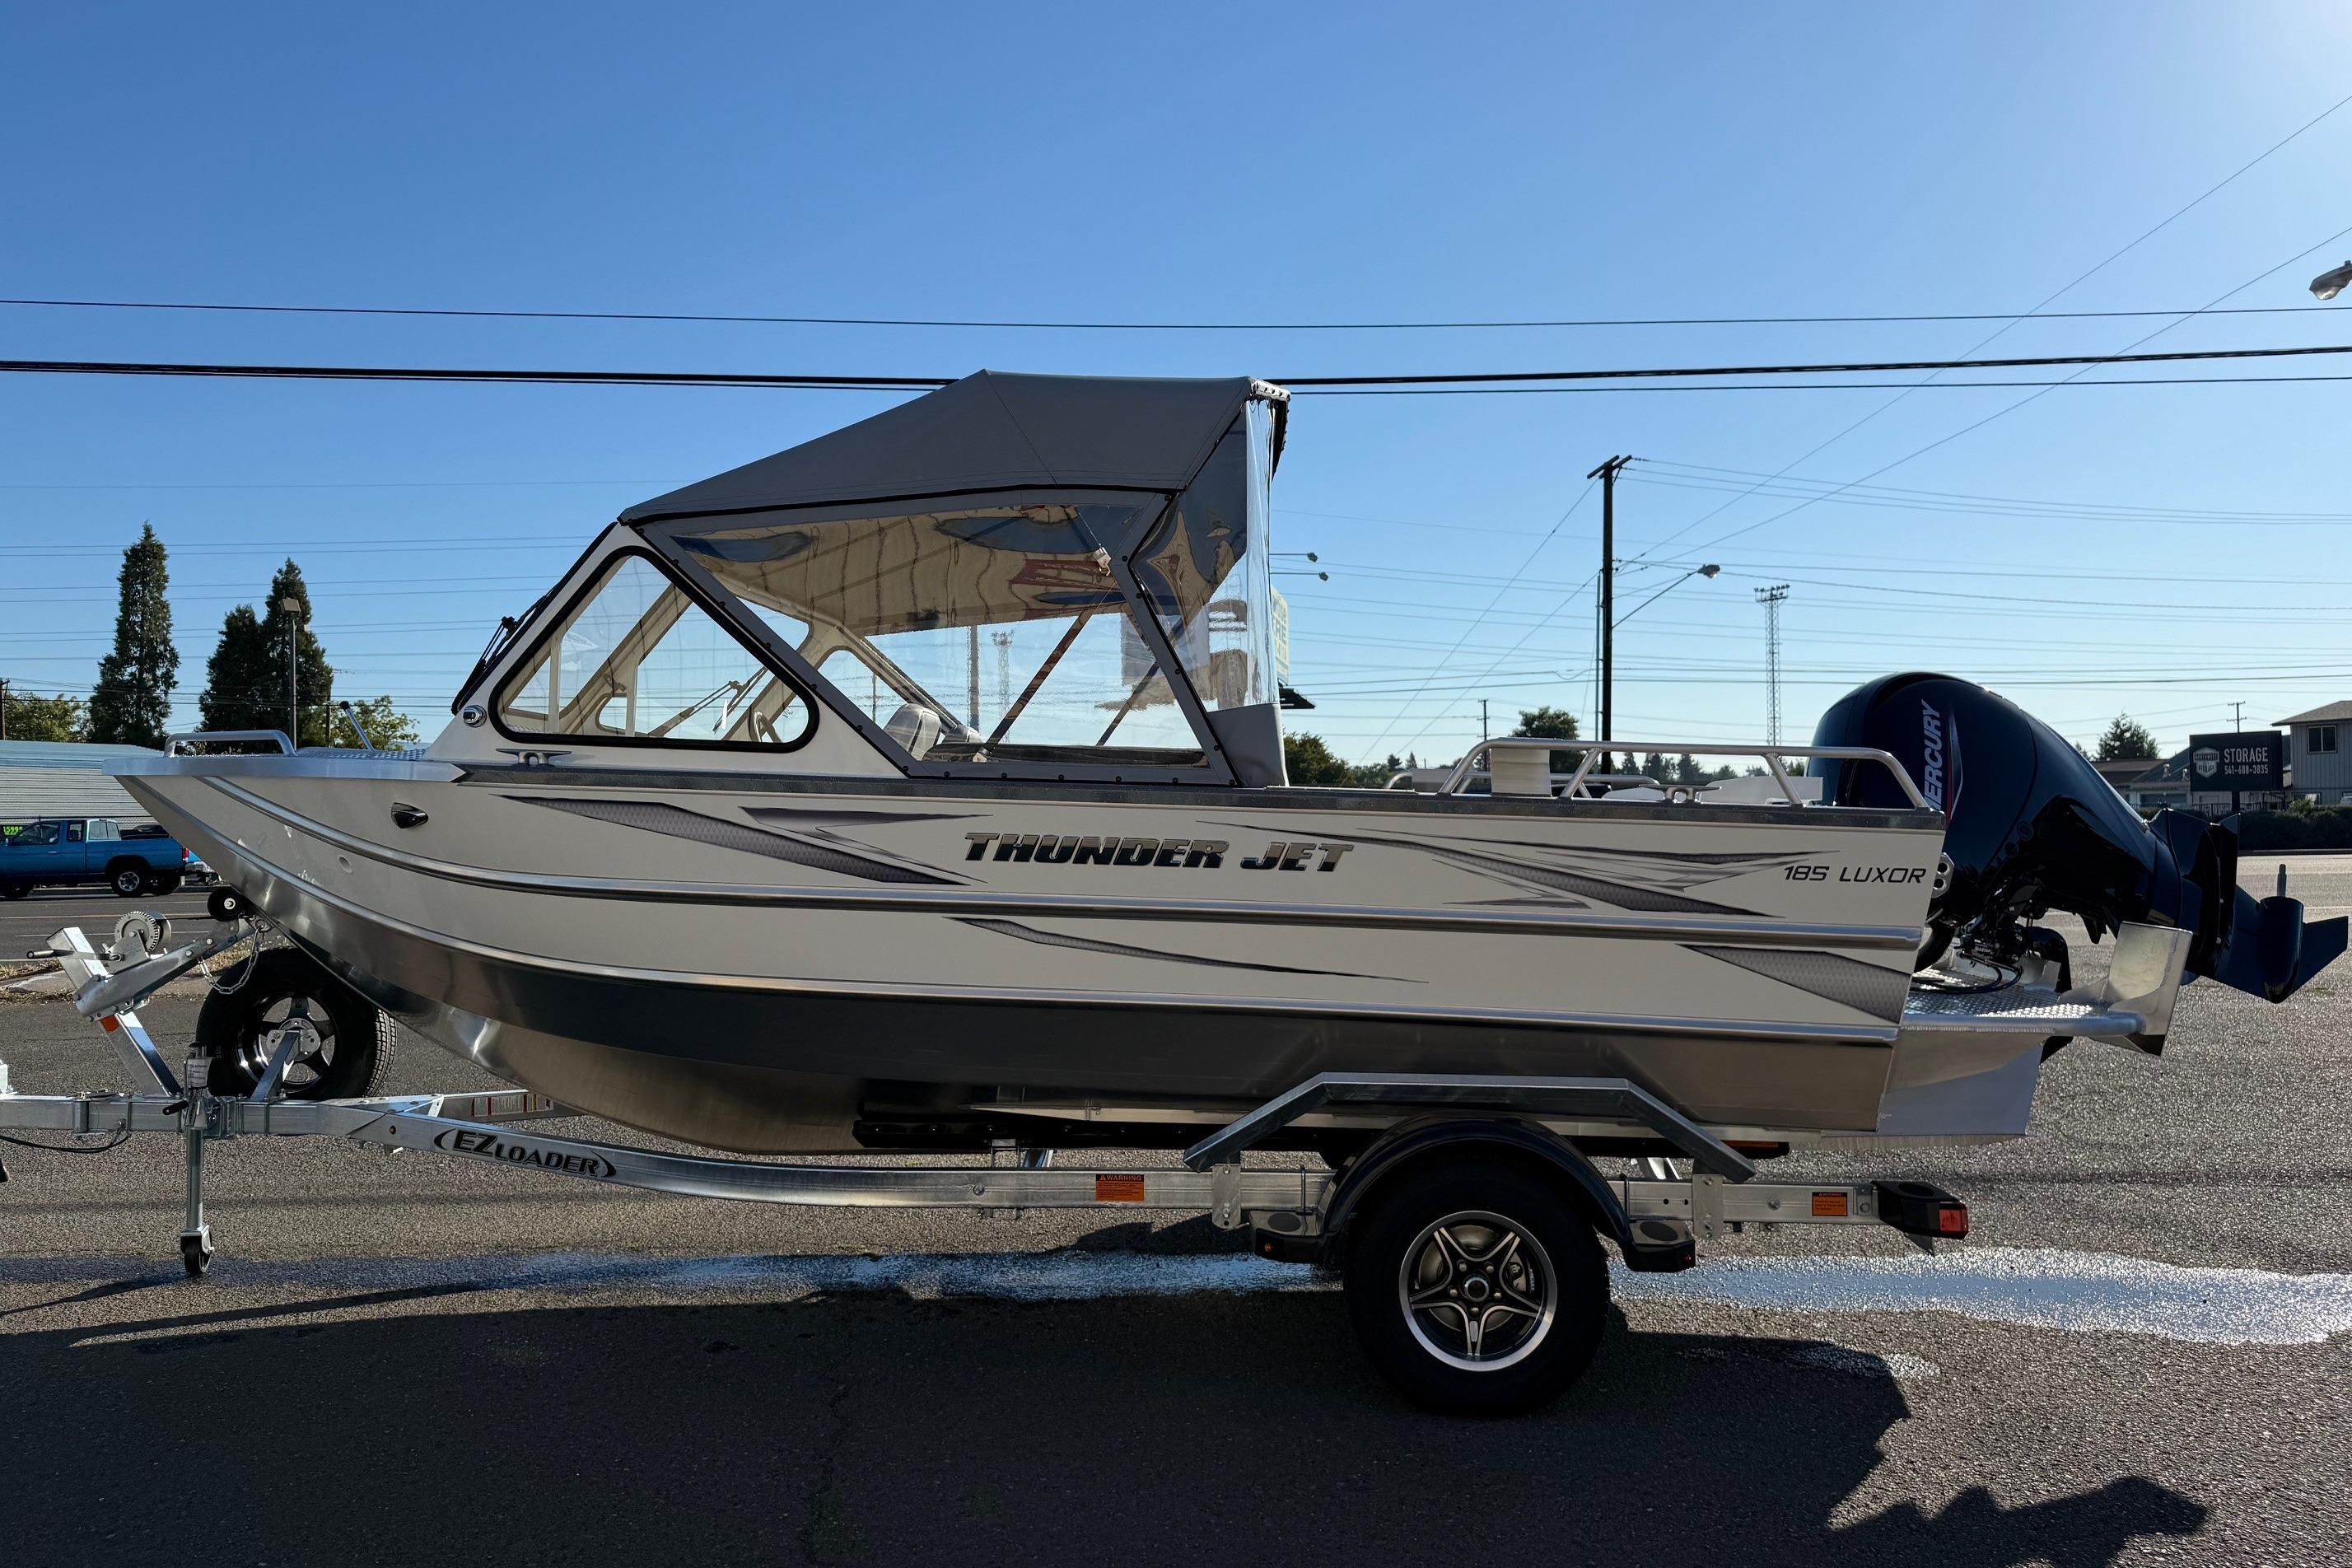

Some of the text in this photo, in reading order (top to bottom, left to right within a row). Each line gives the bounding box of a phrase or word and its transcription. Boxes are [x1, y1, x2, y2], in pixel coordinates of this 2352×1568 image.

[2224, 747, 2268, 763] STORAGE
[964, 832, 1355, 872] THUNDER JET
[1784, 866, 1926, 884] 185 LUXOR
